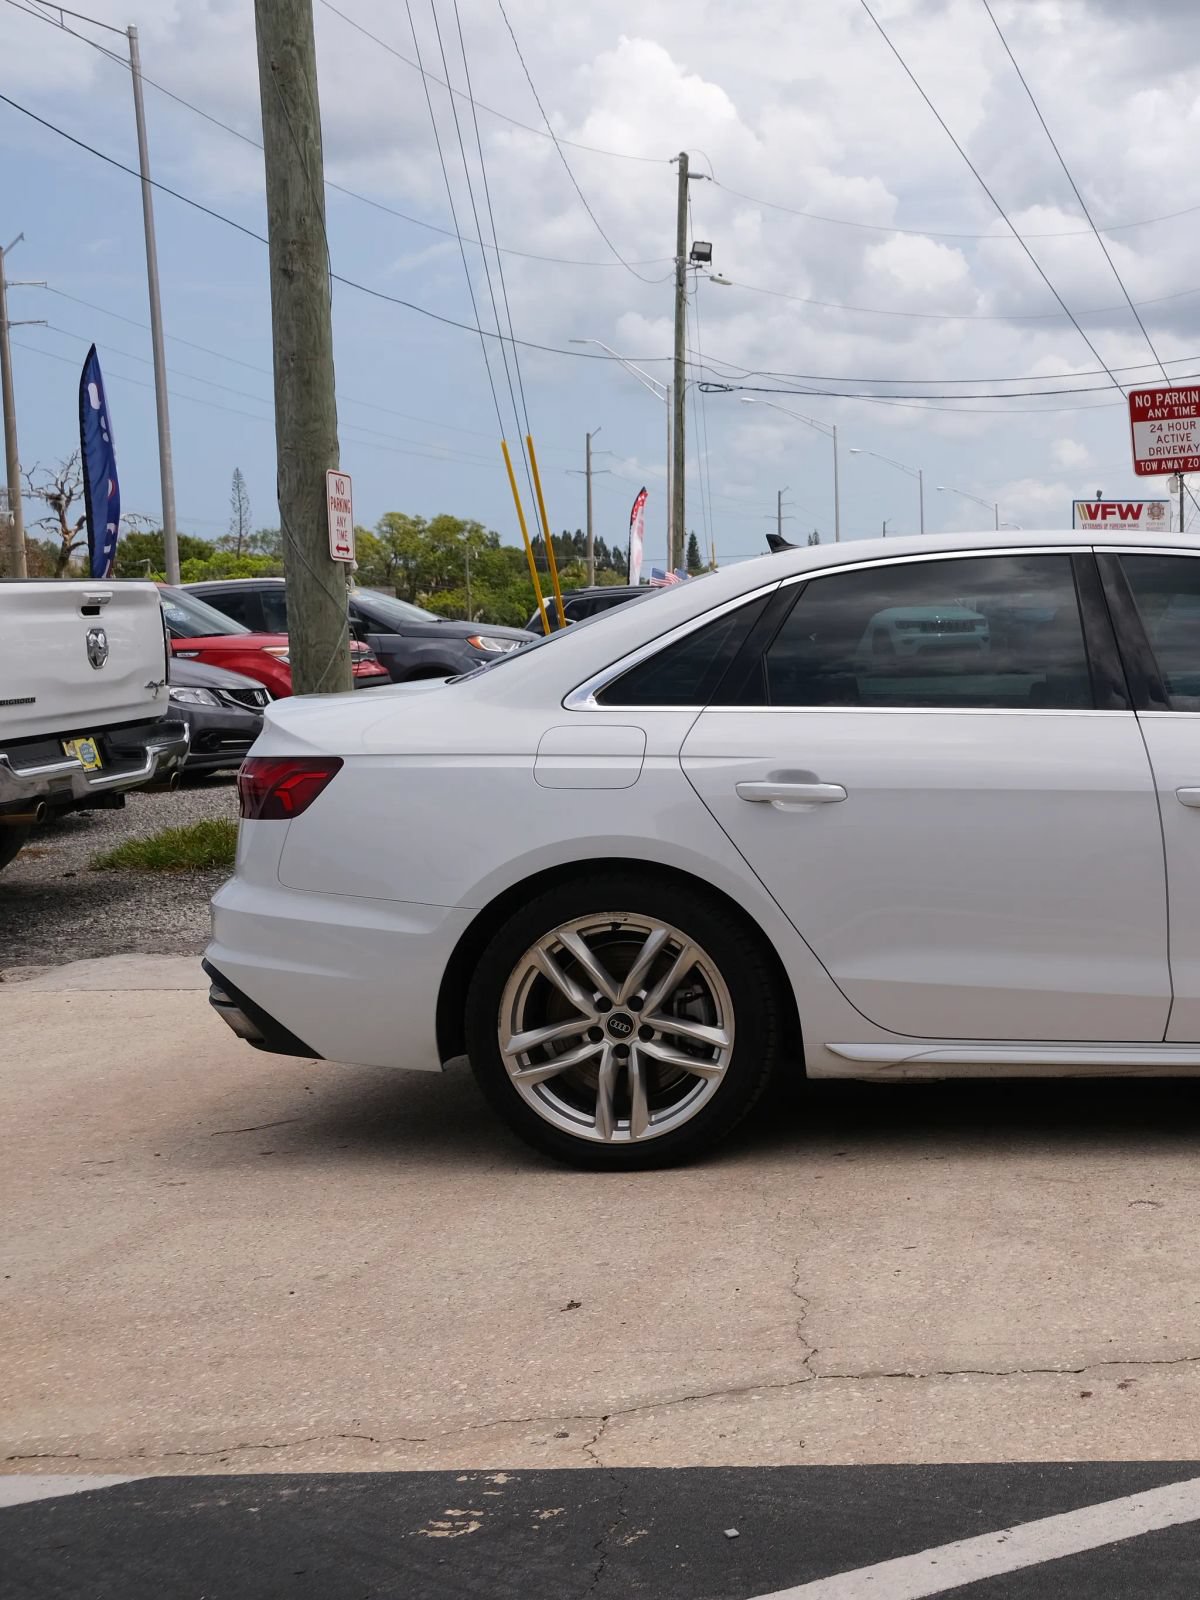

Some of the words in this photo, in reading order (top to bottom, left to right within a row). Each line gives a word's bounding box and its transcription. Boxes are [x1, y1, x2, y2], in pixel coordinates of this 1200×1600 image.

[1135, 394, 1151, 408] NO
[1147, 407, 1169, 419] ANY
[1172, 405, 1197, 417] TIME
[1149, 423, 1163, 433] 24
[1167, 421, 1197, 432] HOUR
[1156, 432, 1193, 444] ACTIVE
[1148, 443, 1200, 456] DRIVEWAY
[1140, 461, 1158, 471] TOW
[1161, 459, 1184, 470] AWAY
[335, 479, 344, 496] NO
[330, 496, 351, 514] PARKING
[1085, 503, 1144, 521] VFW
[336, 515, 346, 528] ANY
[336, 529, 348, 542] TIME
